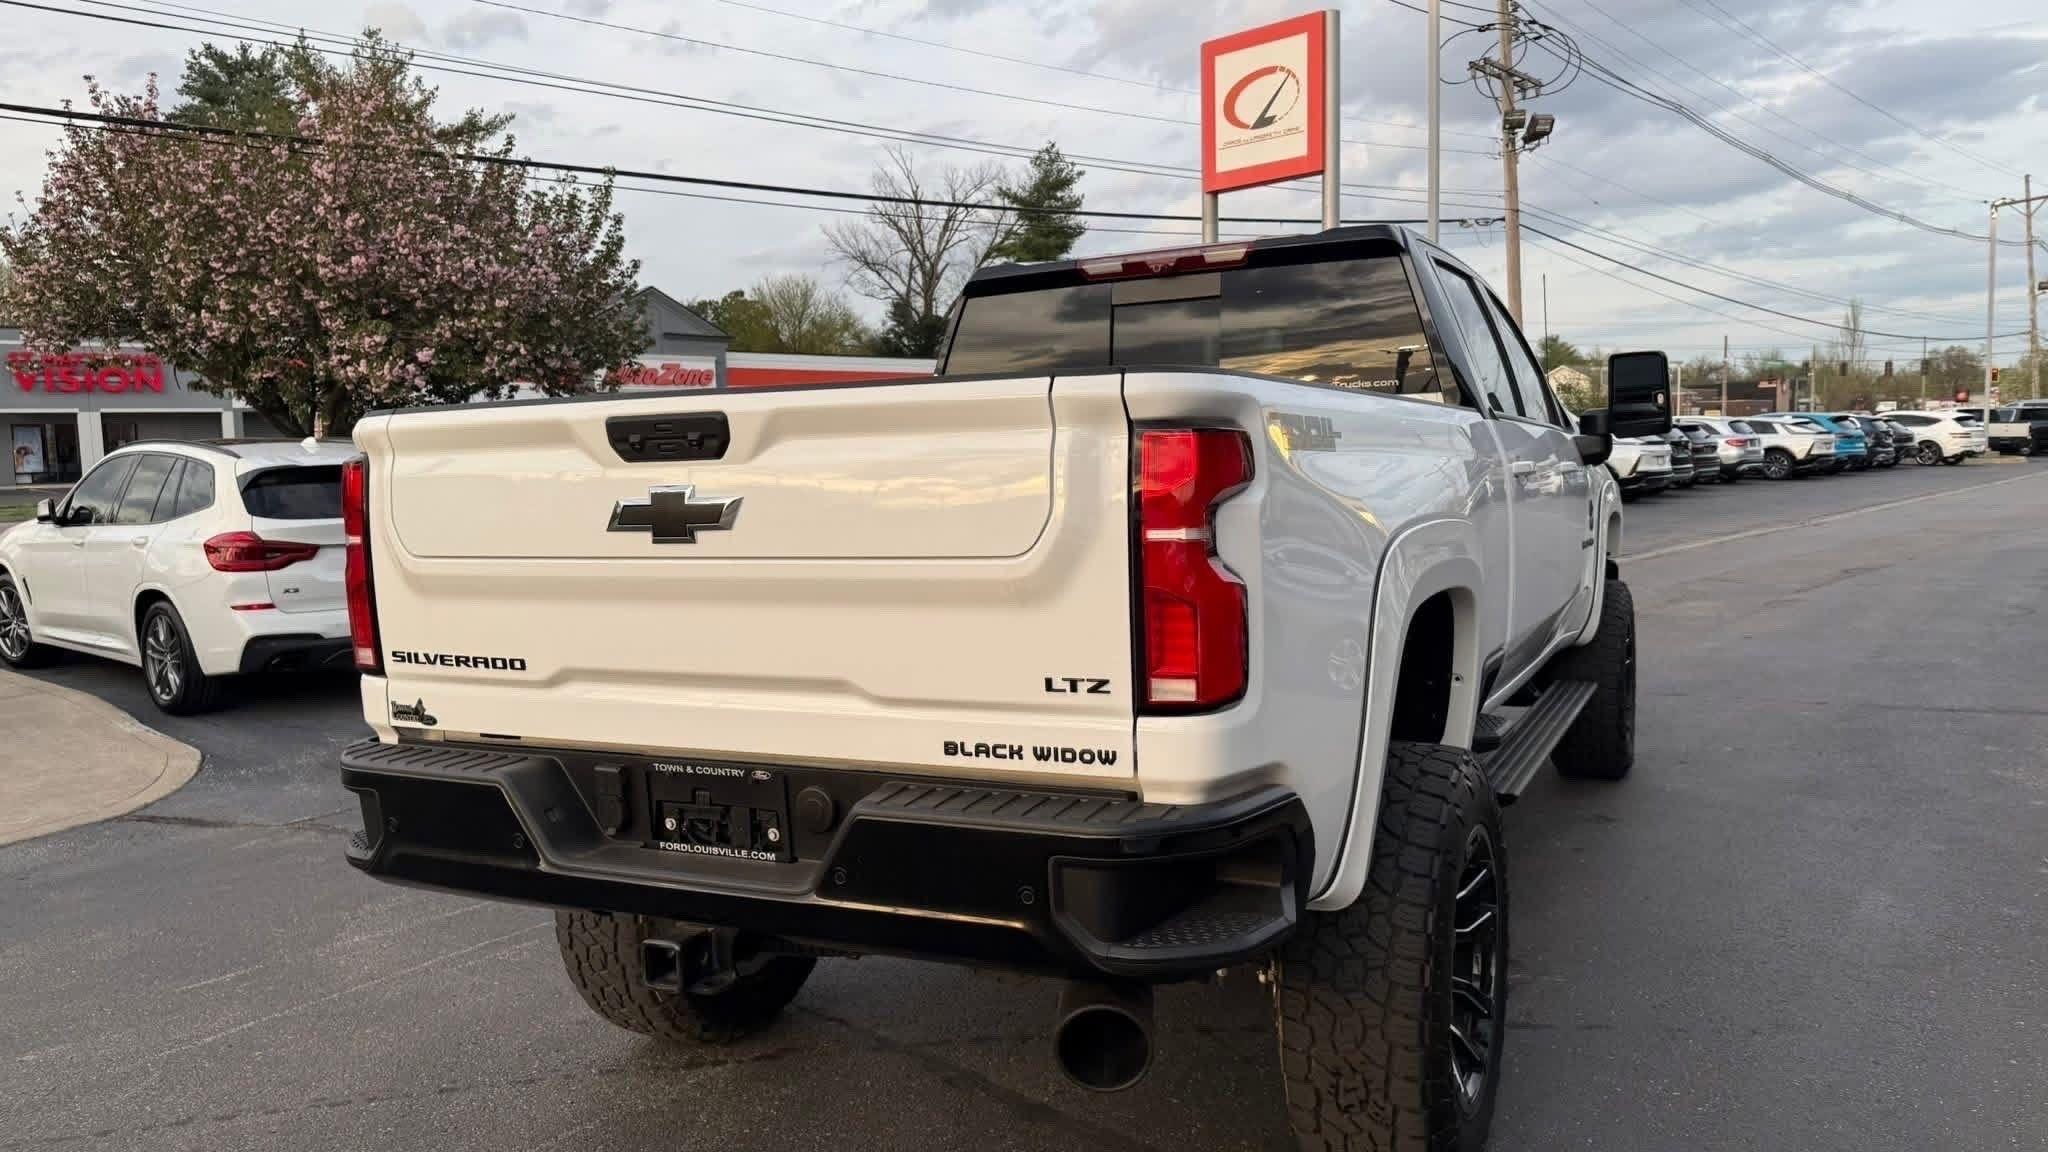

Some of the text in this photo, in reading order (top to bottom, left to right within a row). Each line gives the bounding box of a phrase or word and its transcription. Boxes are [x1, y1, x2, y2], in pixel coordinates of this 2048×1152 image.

[13, 367, 165, 393] VISION
[391, 650, 528, 671] SILVERADO
[1044, 676, 1111, 694] LTZ
[943, 740, 1118, 766] BLACK WIDOW
[653, 763, 684, 774] TOWN
[686, 766, 694, 774] &
[696, 766, 745, 778] COUNTRY
[659, 841, 777, 862] FORDLOUISVILLE.COM
